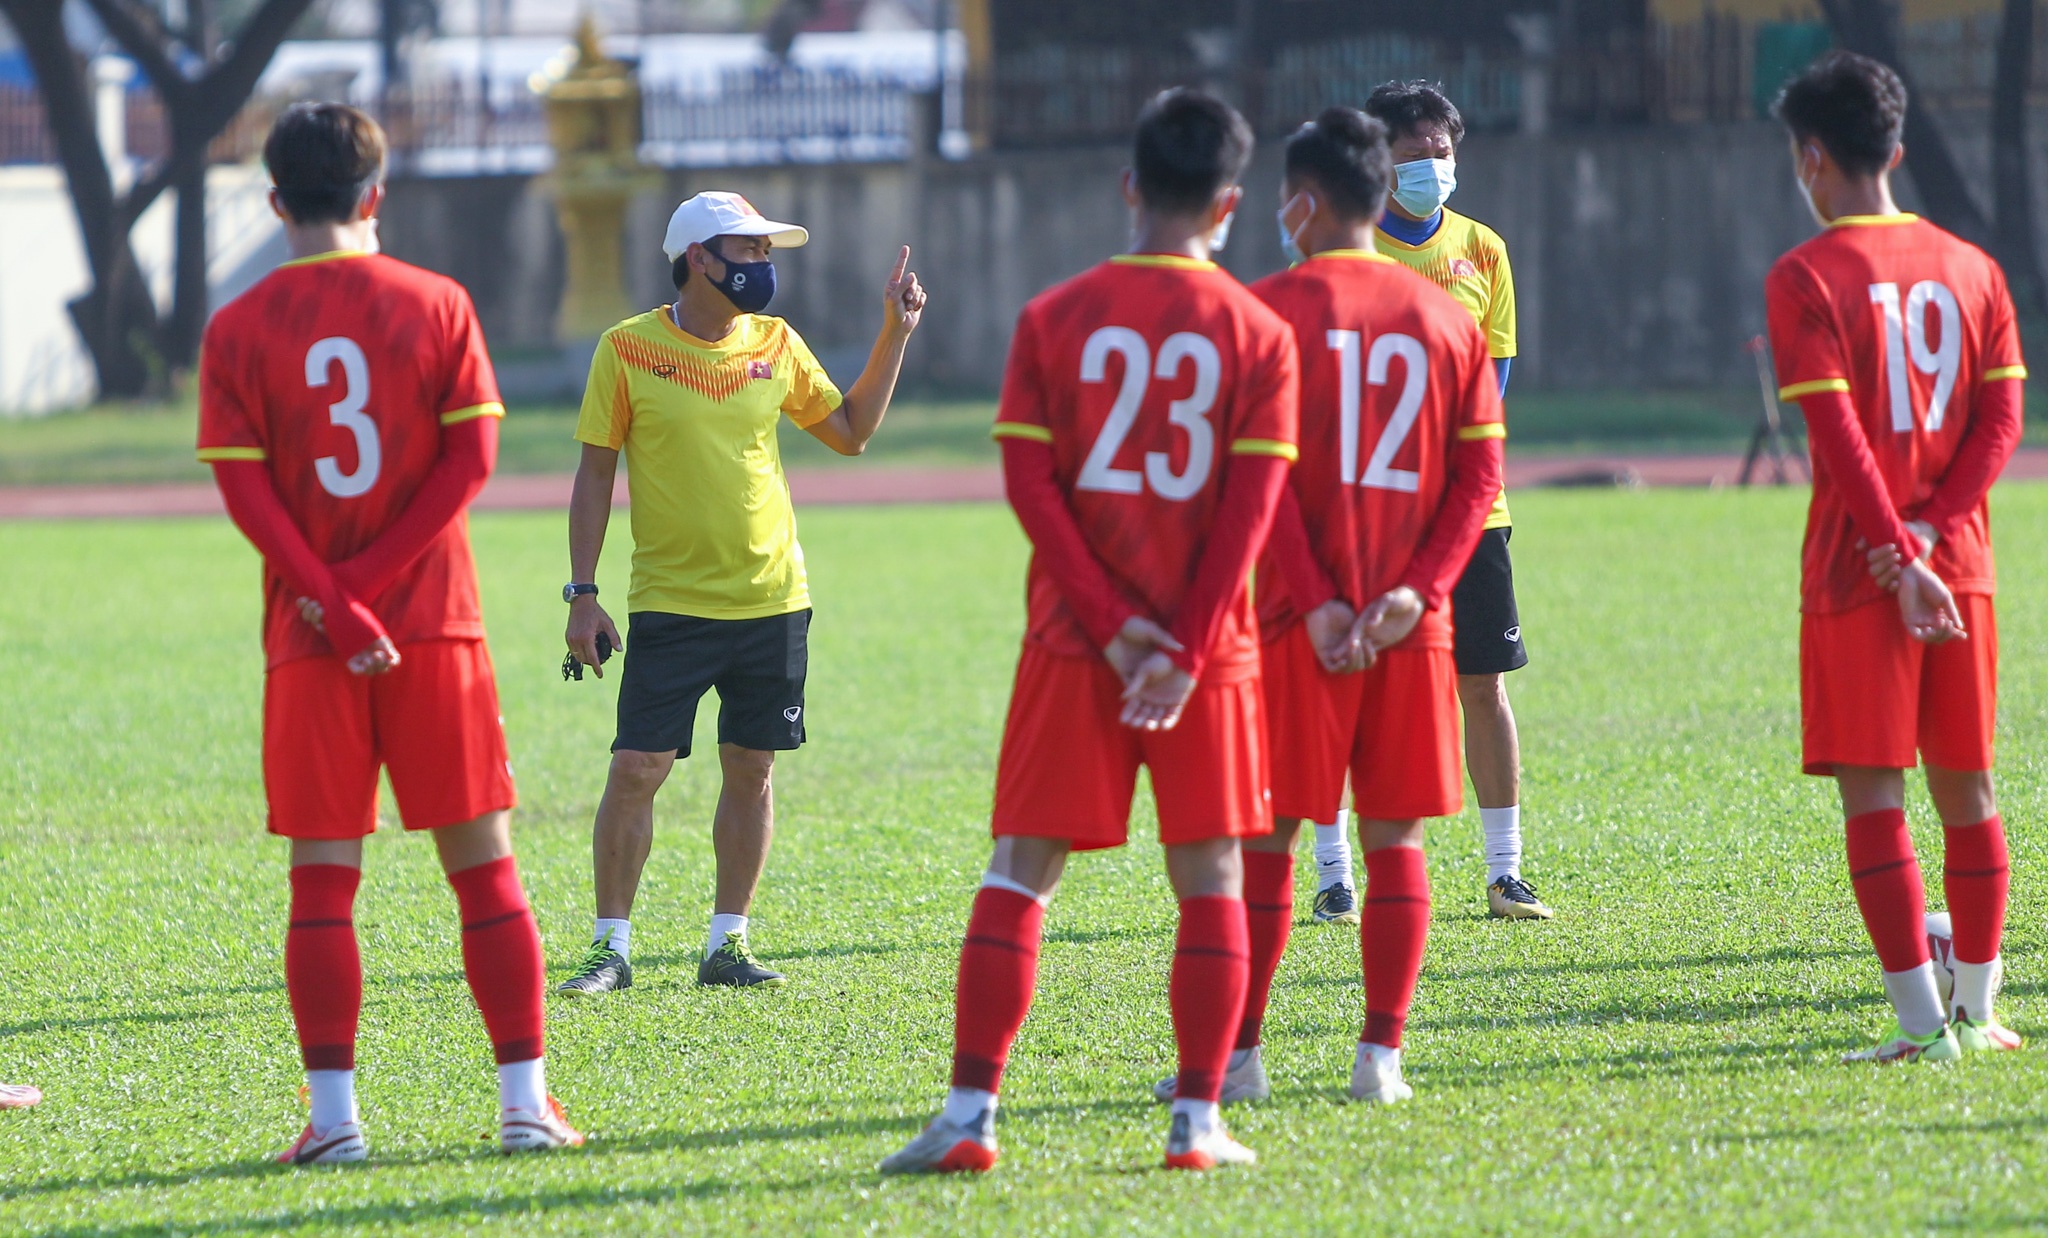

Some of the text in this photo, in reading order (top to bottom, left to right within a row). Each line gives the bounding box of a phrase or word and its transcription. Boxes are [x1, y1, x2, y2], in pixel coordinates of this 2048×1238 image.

[305, 337, 381, 498] 3
[1076, 326, 1222, 502] 23
[1327, 328, 1428, 493] 12
[1868, 280, 1962, 433] 19
